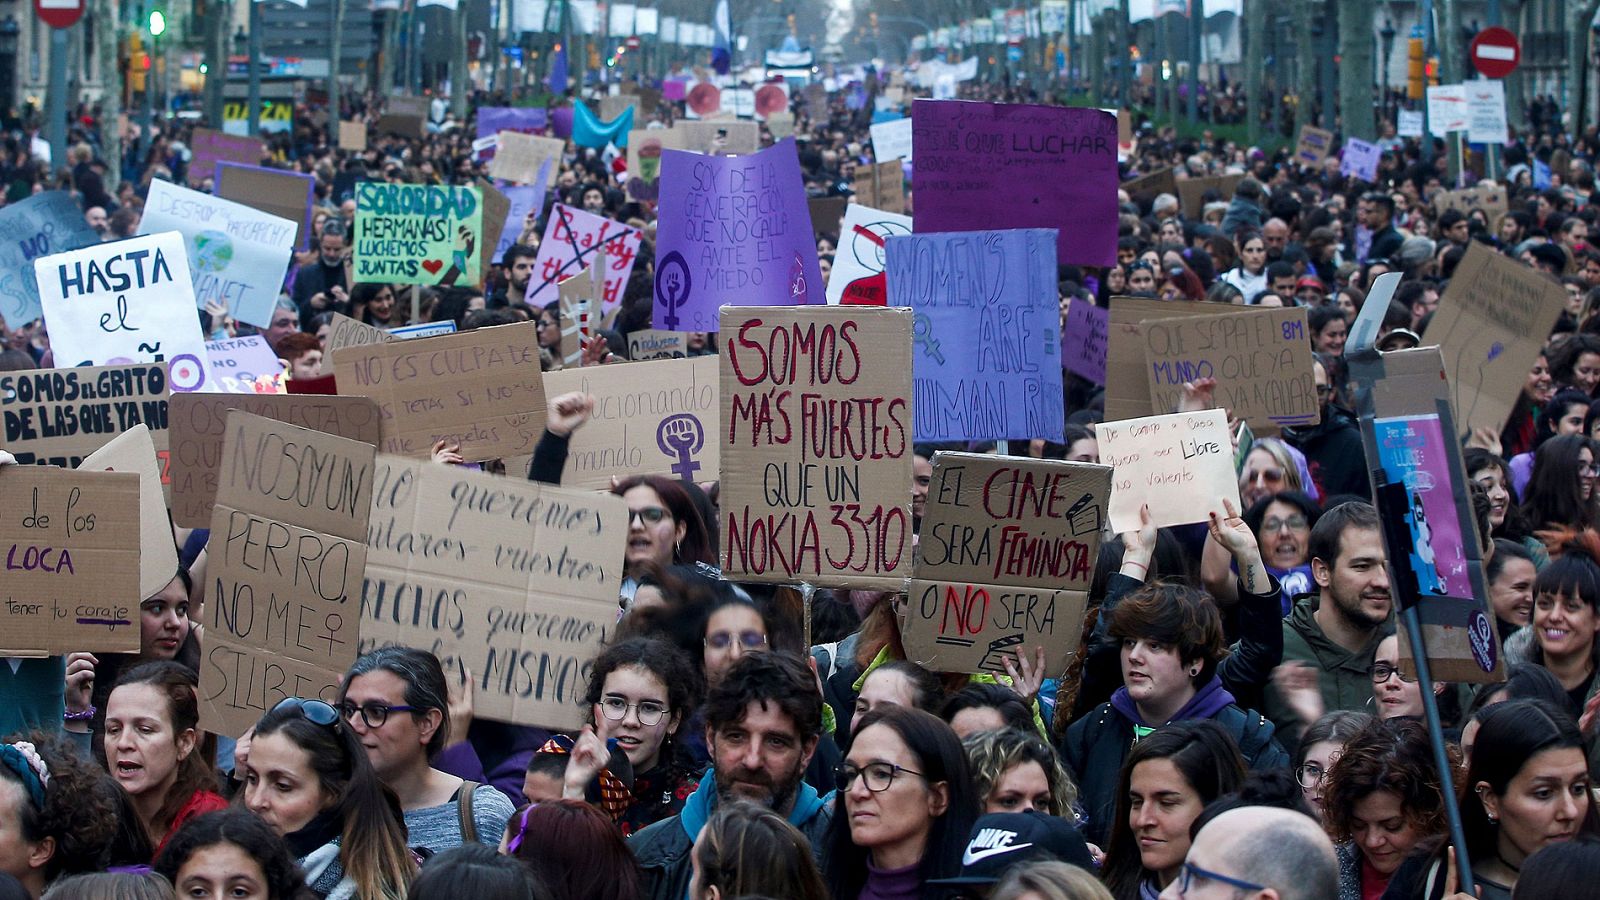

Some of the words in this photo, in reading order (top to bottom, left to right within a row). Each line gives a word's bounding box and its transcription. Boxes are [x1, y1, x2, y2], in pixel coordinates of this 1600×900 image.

[1012, 133, 1112, 156] LUCHAR
[690, 161, 722, 193] SOY
[730, 166, 756, 193] DE
[761, 162, 777, 189] LA
[363, 218, 452, 242] HERMANAS!
[685, 219, 714, 242] QUE
[721, 220, 748, 244] NO
[751, 212, 788, 238] CALLA
[358, 259, 418, 277] JUNTAS
[359, 240, 429, 257] LUCHEMOS
[701, 245, 746, 266] ANTE
[758, 240, 782, 262] EL
[58, 247, 173, 299] HASTA
[100, 295, 139, 332] el
[728, 318, 860, 386] SOMOS
[978, 304, 1039, 373] ARE
[1148, 325, 1188, 356] QUE
[1195, 317, 1248, 351] SEPA
[1256, 314, 1281, 347] EL
[1282, 320, 1304, 340] 8M
[212, 359, 238, 368] NO
[354, 355, 383, 386] NO
[392, 354, 418, 382] ES
[430, 346, 504, 376] CULPA
[509, 345, 532, 364] DE
[1153, 360, 1214, 385] MUNDO
[1222, 351, 1260, 380] QUE
[1269, 348, 1295, 374] YA
[1, 372, 80, 404] SOMOS
[81, 382, 96, 400] EL
[97, 366, 165, 398] GRITO
[378, 402, 392, 420] IS
[456, 390, 473, 406] SI
[486, 385, 512, 400] NO
[4, 408, 37, 442] DE
[38, 404, 78, 438] LAS
[80, 403, 114, 434] QUE
[114, 402, 142, 432] YA
[142, 400, 168, 430] NO
[190, 401, 226, 436] OS
[729, 386, 793, 447] MÁS
[801, 393, 906, 463] FUERTES
[570, 424, 642, 472] mundo
[1180, 438, 1220, 460] Libre
[174, 472, 193, 494] LA
[764, 462, 818, 508] QUE
[825, 464, 860, 502] UN
[938, 466, 970, 508] EL
[983, 468, 1071, 520] CINE
[22, 487, 50, 529] de
[66, 487, 96, 538] los
[448, 480, 602, 535] queremos
[726, 505, 821, 576] NOKIA
[825, 504, 907, 574] 3310
[924, 523, 998, 566] SERÁ
[6, 544, 74, 576] LOCA
[6, 596, 43, 616] tener
[51, 598, 68, 621] tu
[75, 604, 130, 632] coraje
[214, 577, 254, 638] NO
[265, 592, 316, 651] ME
[487, 604, 607, 645] queremos
[920, 584, 938, 620] O
[939, 583, 990, 636] NO
[993, 586, 1064, 636] SERÁ
[482, 646, 592, 707] MISMOS
[971, 828, 1018, 848] NIKE
